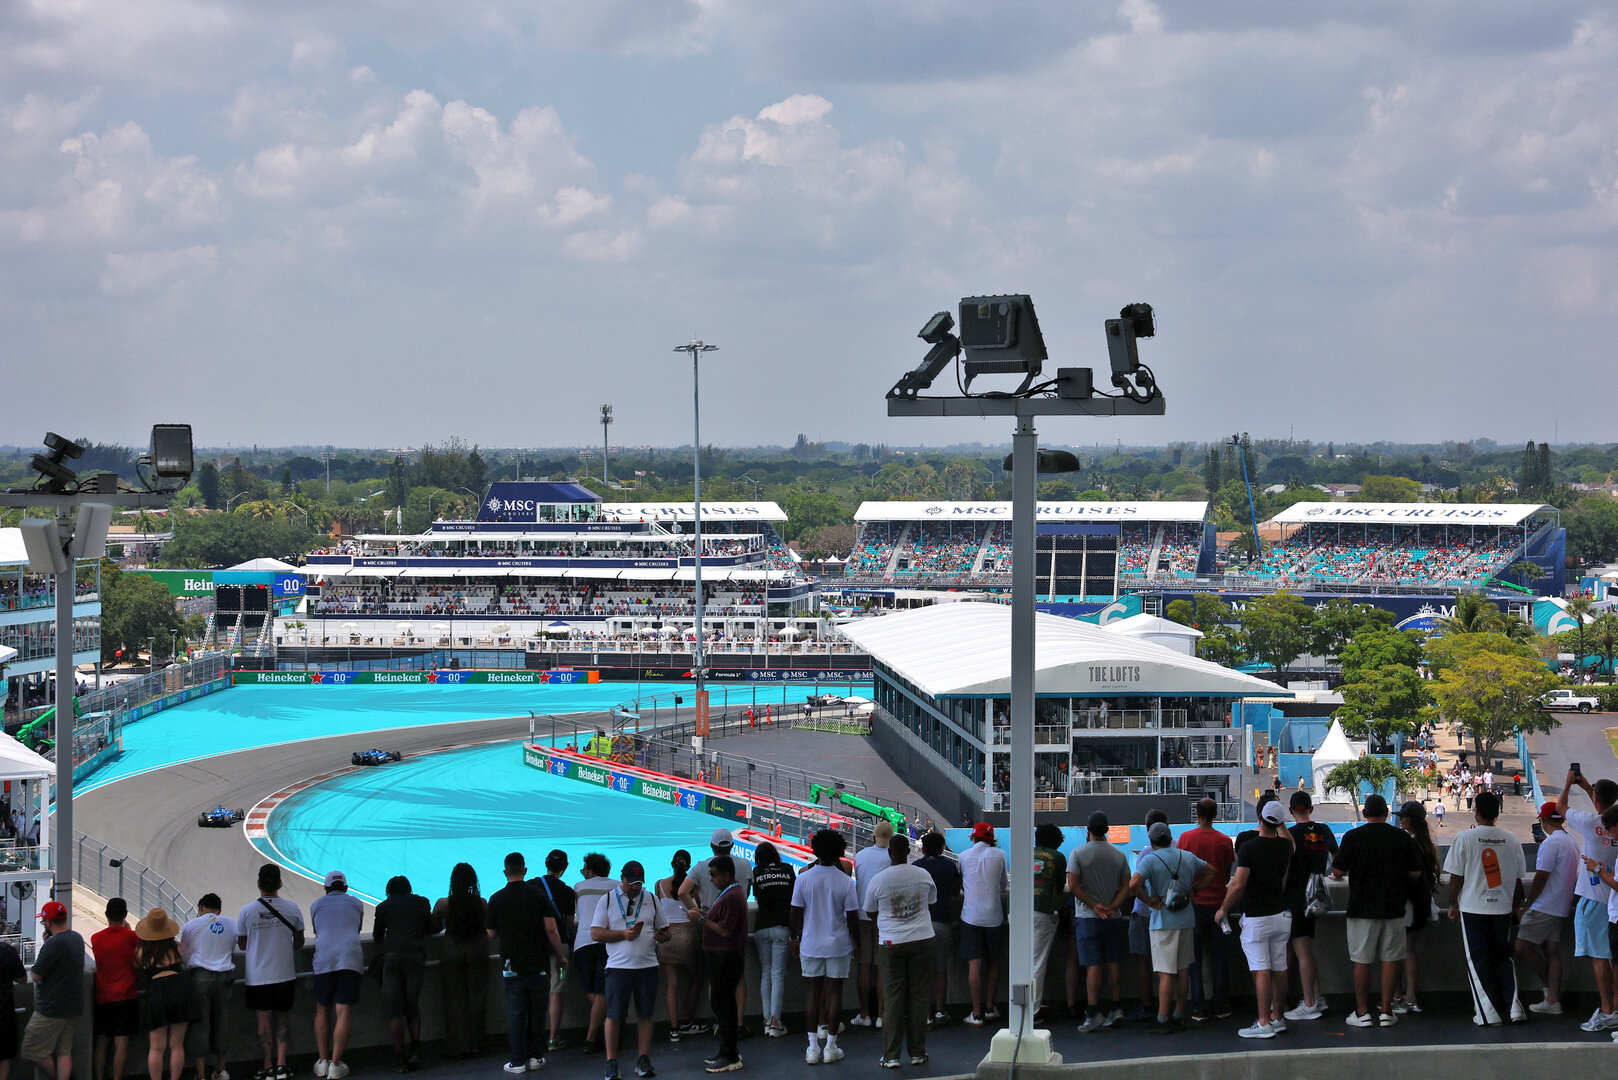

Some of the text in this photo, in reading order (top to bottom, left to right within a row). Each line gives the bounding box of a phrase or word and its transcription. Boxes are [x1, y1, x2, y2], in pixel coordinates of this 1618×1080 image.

[504, 500, 534, 511] MSC
[1388, 509, 1507, 517] CRUISES
[284, 579, 299, 591] 0.0
[257, 673, 306, 682] Heineken
[374, 673, 421, 682] Heineken
[488, 673, 534, 682] Heineken
[1089, 666, 1140, 681] THE LOFTS
[526, 752, 544, 768] Heineken
[578, 766, 605, 784] Heineken
[642, 782, 671, 800] Heineken
[756, 873, 791, 882] PETRONAS
[212, 923, 223, 934] hp
